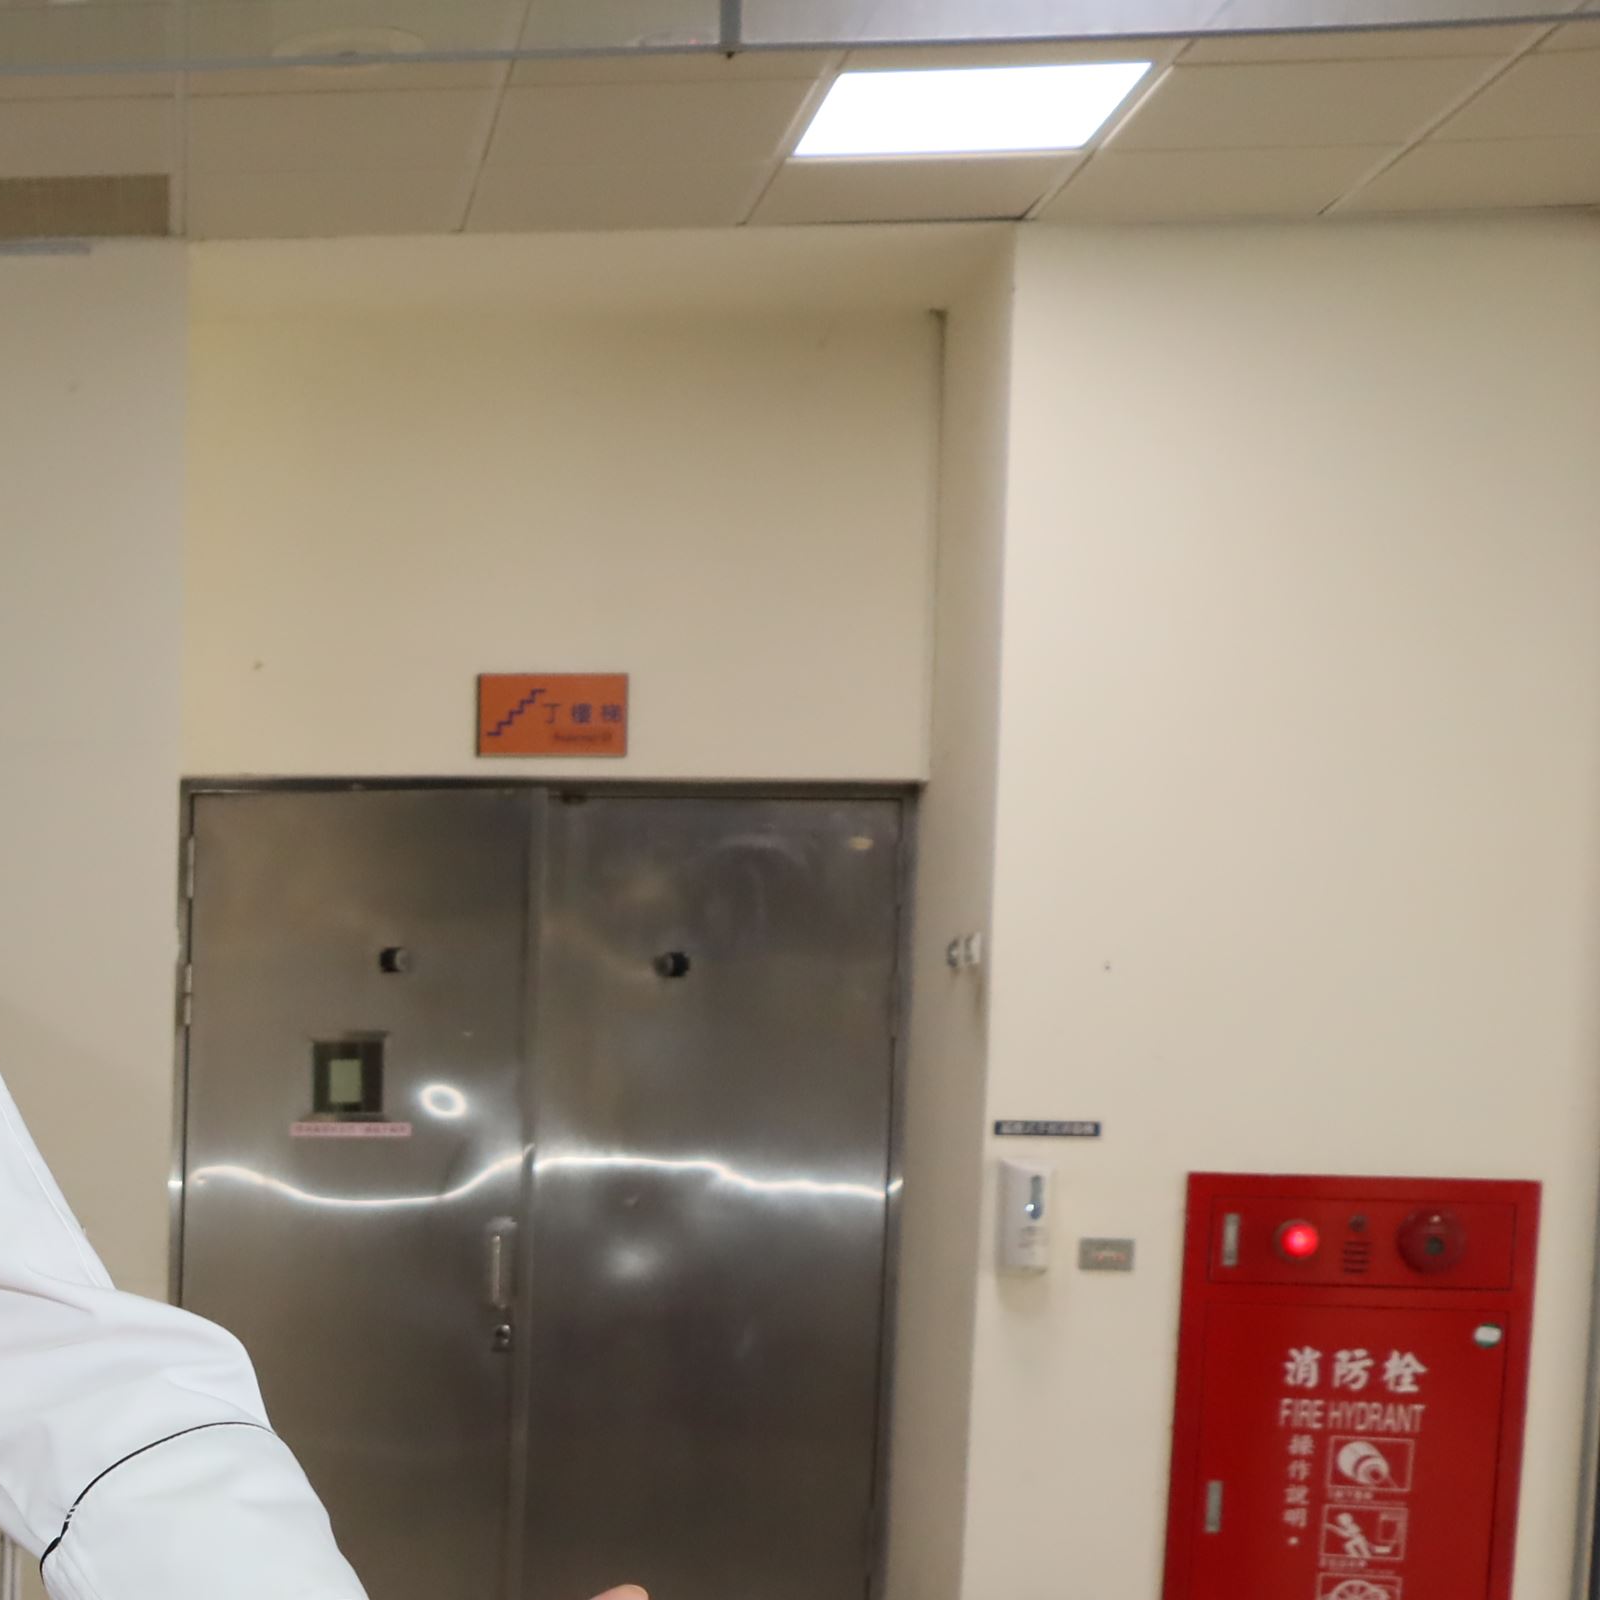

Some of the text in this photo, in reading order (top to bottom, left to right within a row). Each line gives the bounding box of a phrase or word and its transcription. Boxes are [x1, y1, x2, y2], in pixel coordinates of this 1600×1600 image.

[1283, 1345, 1429, 1393] 消防栓
[1279, 1398, 1427, 1433] FIRE HYDRANT
